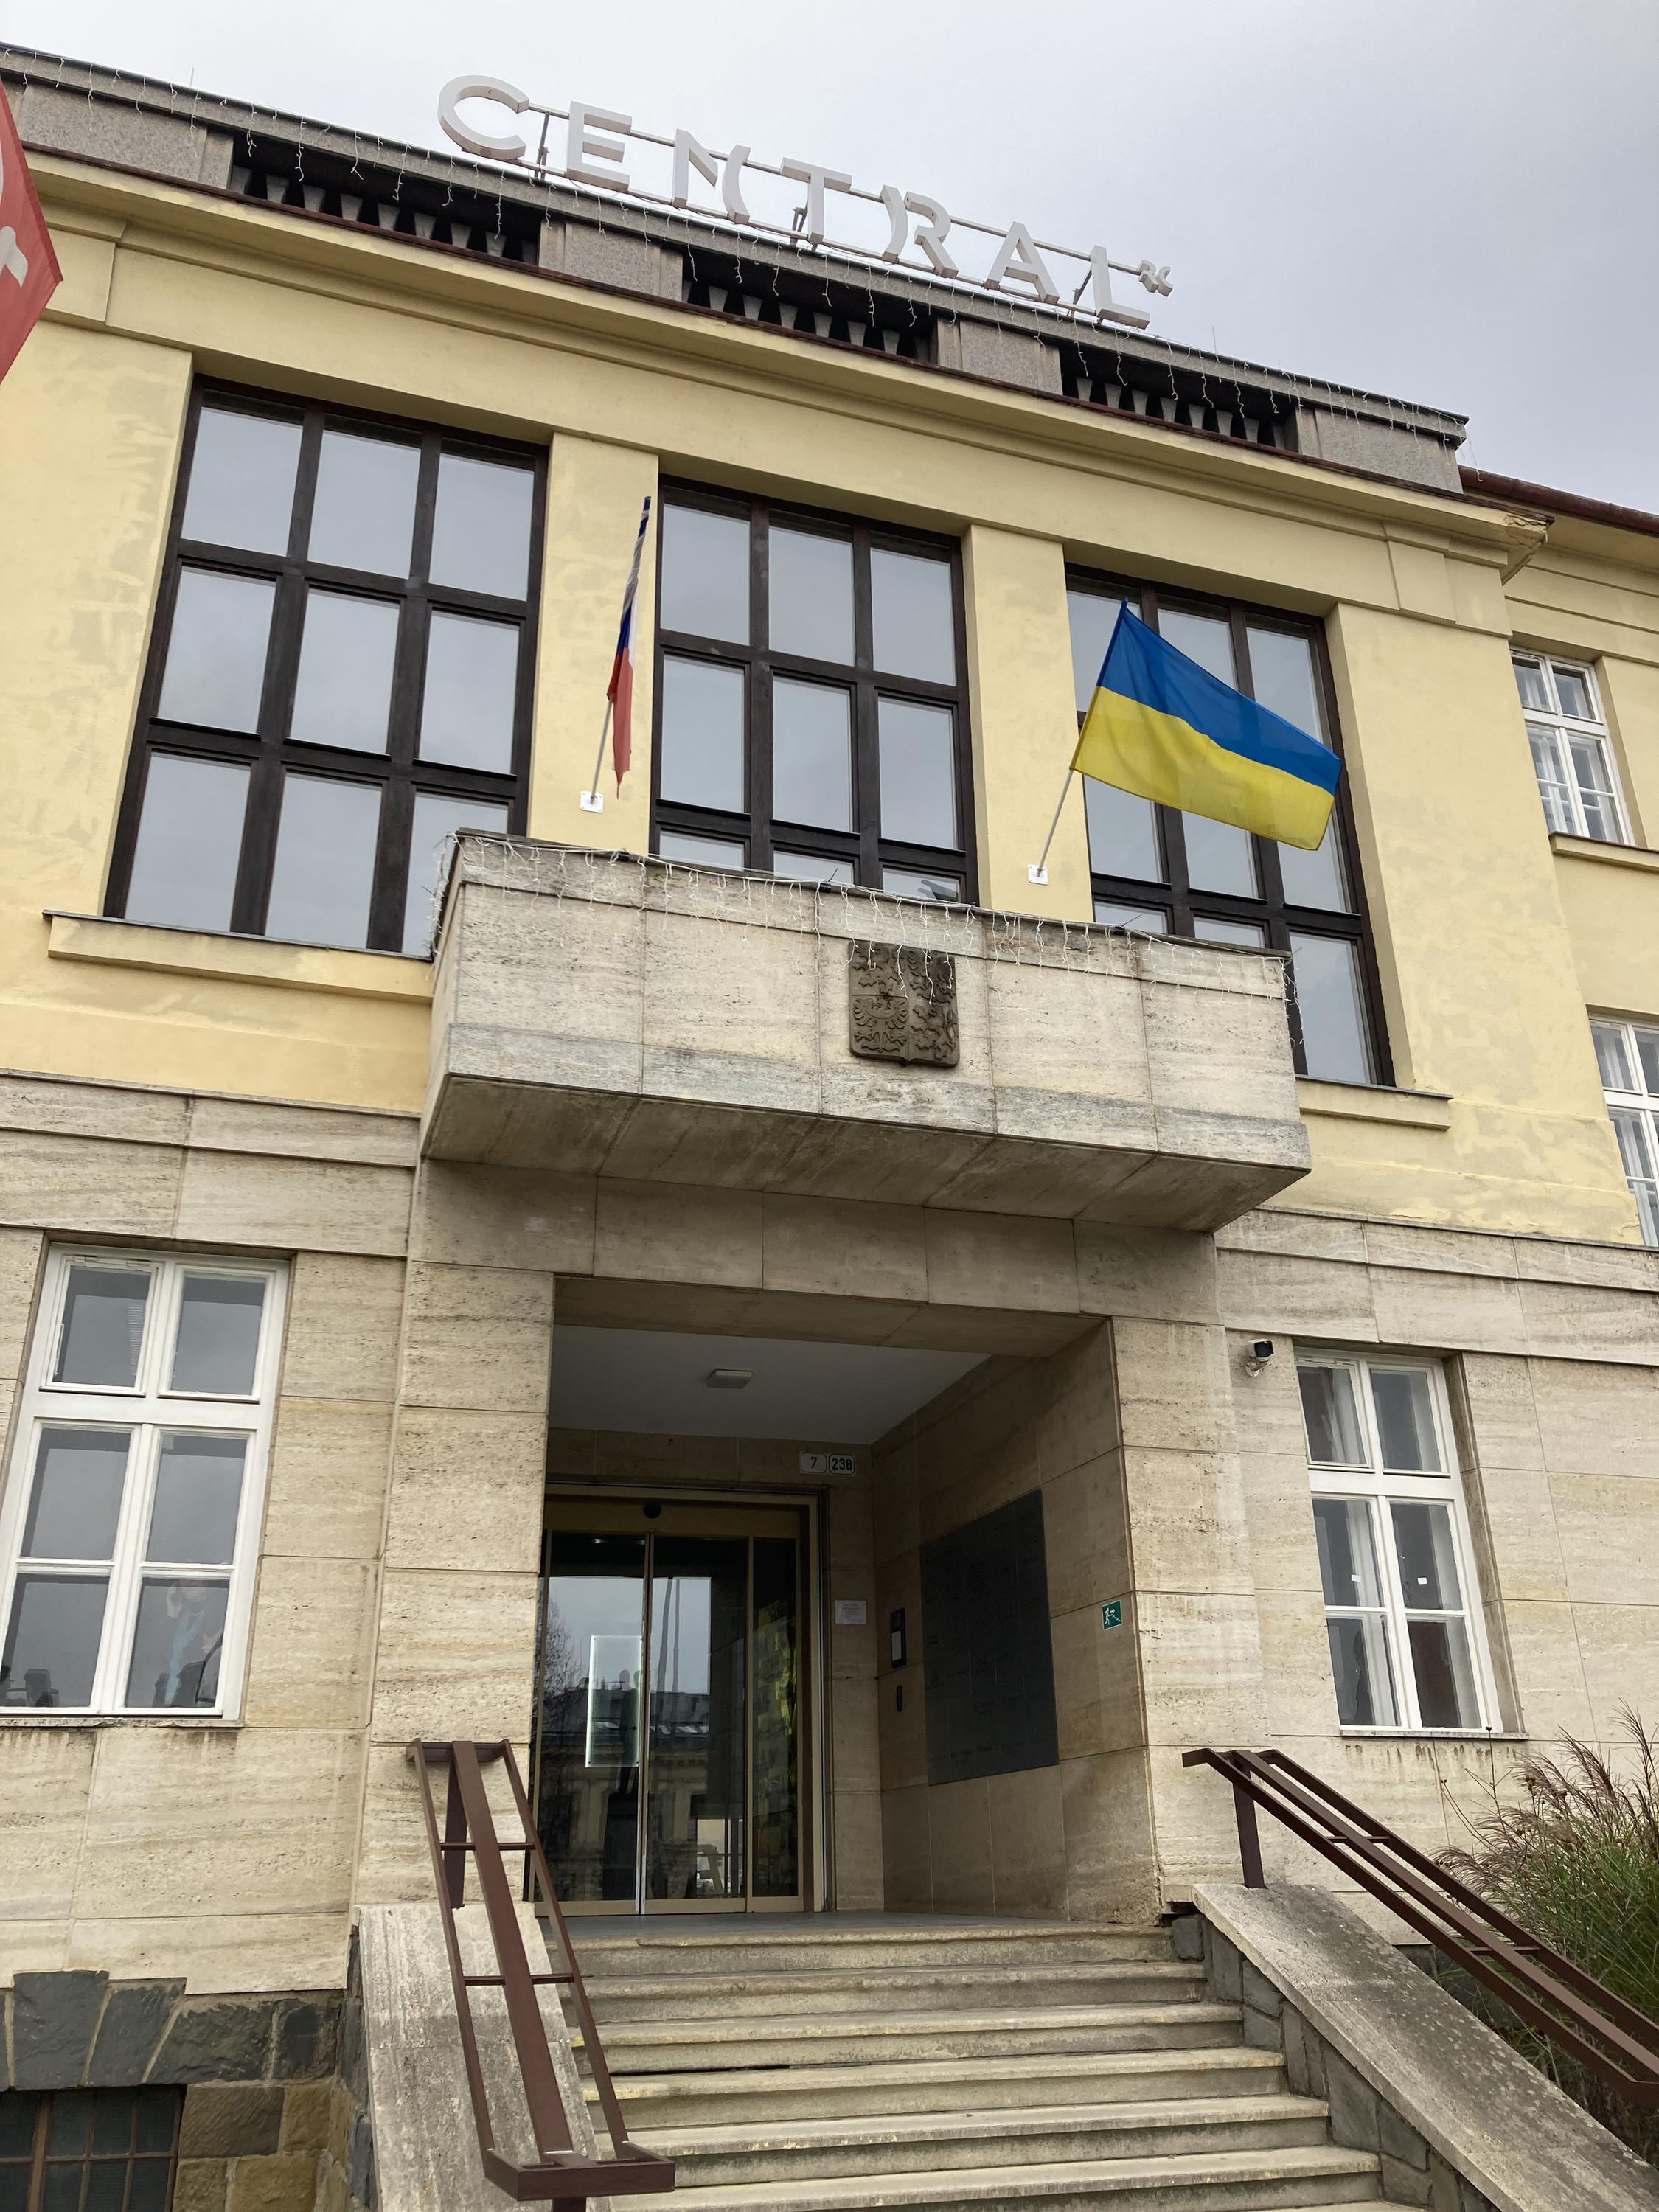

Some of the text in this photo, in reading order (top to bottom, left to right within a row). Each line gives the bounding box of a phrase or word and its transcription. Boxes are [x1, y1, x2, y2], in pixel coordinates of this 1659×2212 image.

[437, 74, 1150, 329] CENTRAL
[810, 1456, 818, 1469] 7
[831, 1458, 853, 1471] 238
